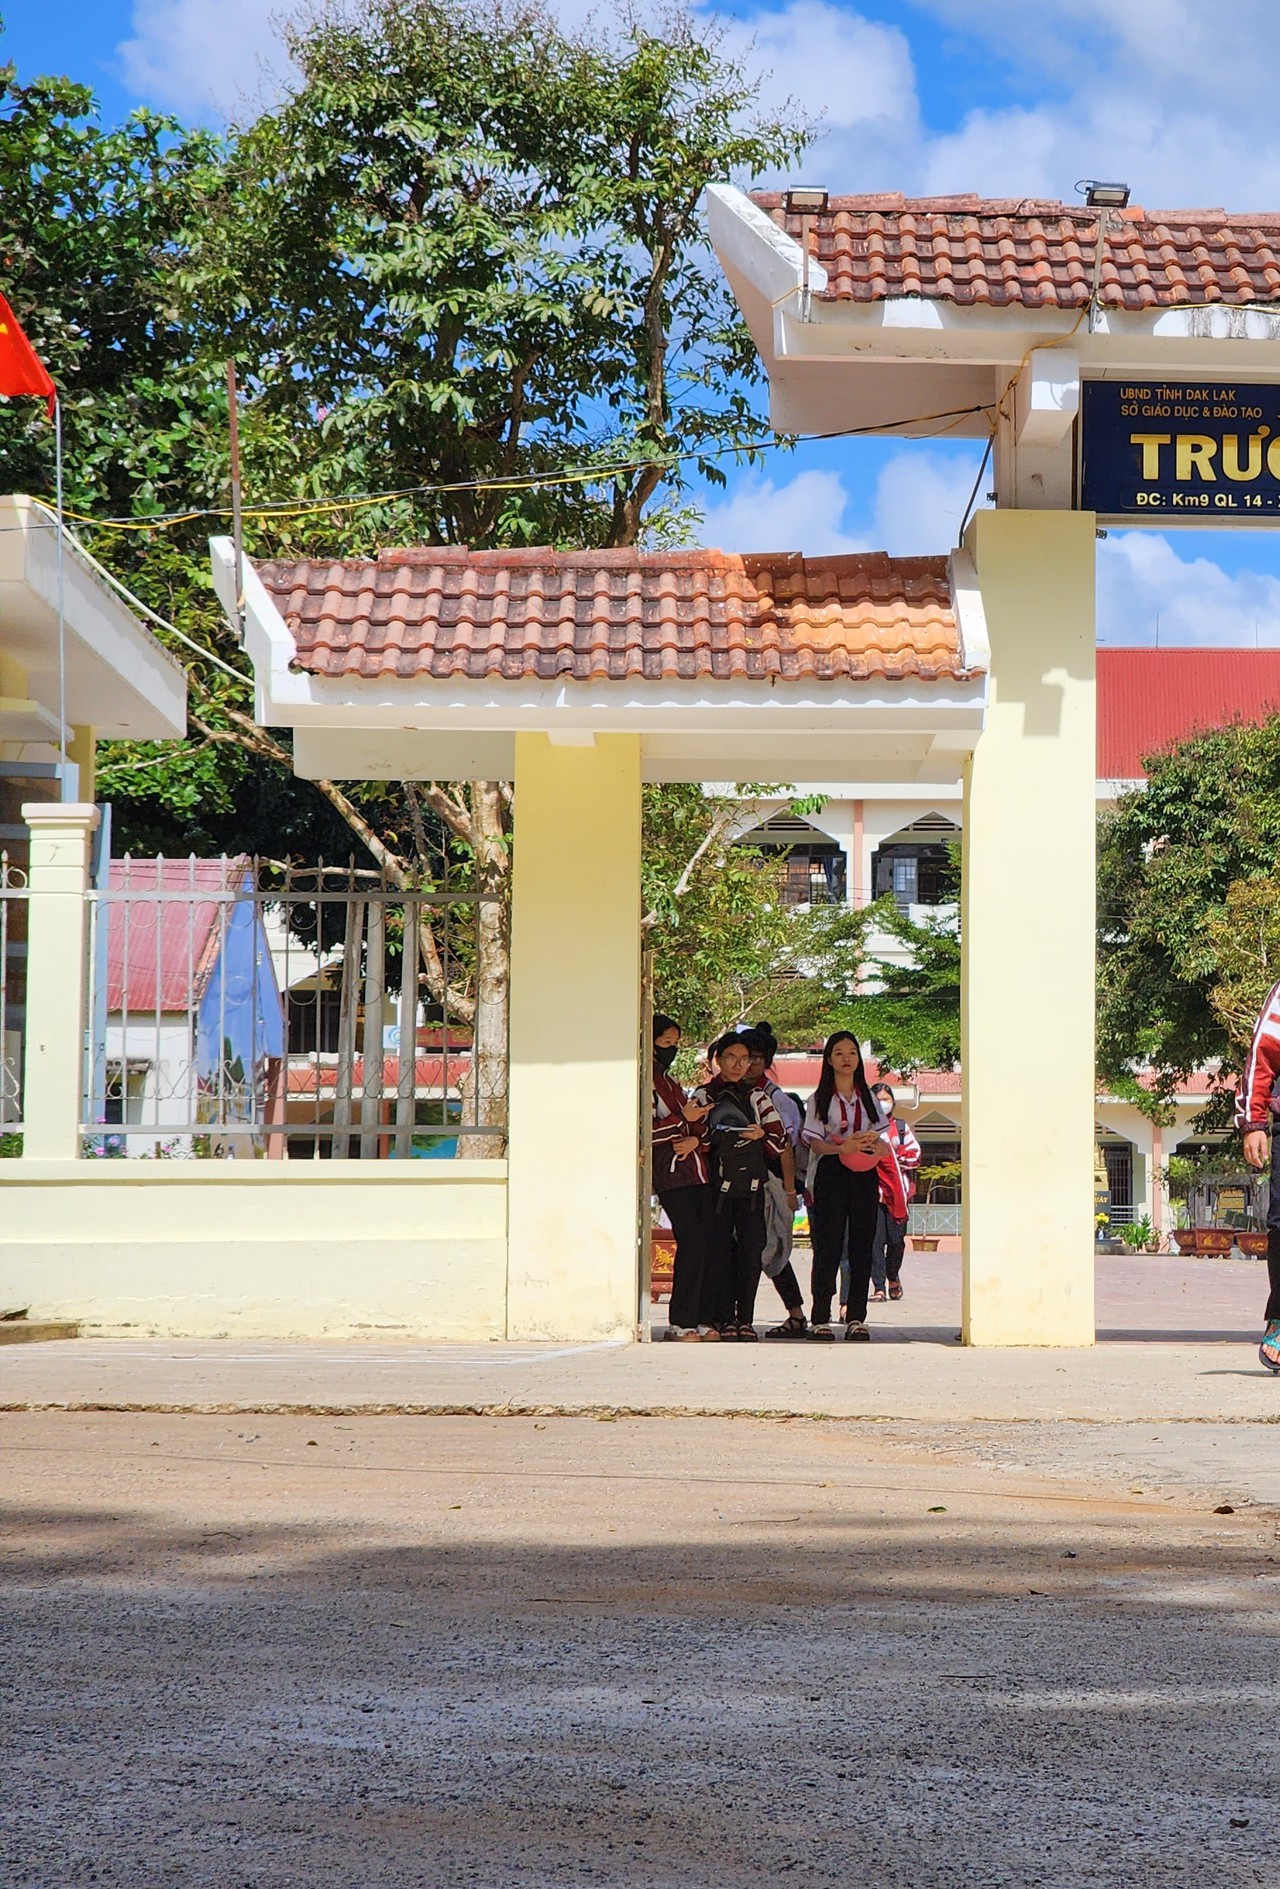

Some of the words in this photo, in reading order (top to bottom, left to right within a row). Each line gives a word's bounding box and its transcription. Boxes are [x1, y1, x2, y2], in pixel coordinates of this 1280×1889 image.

[1120, 388, 1151, 399] UBND
[1155, 385, 1182, 400] TỈNH
[1213, 390, 1236, 400] LAK
[1121, 401, 1138, 416] SỞ
[1142, 403, 1171, 417] GIÁO
[1174, 406, 1199, 420] DỤC
[1202, 407, 1210, 417] &
[1213, 404, 1237, 418] ĐÀO
[1136, 492, 1166, 506] ĐC:
[1172, 493, 1209, 507] Km9
[1214, 493, 1238, 508] QL
[1243, 495, 1262, 508] 14
